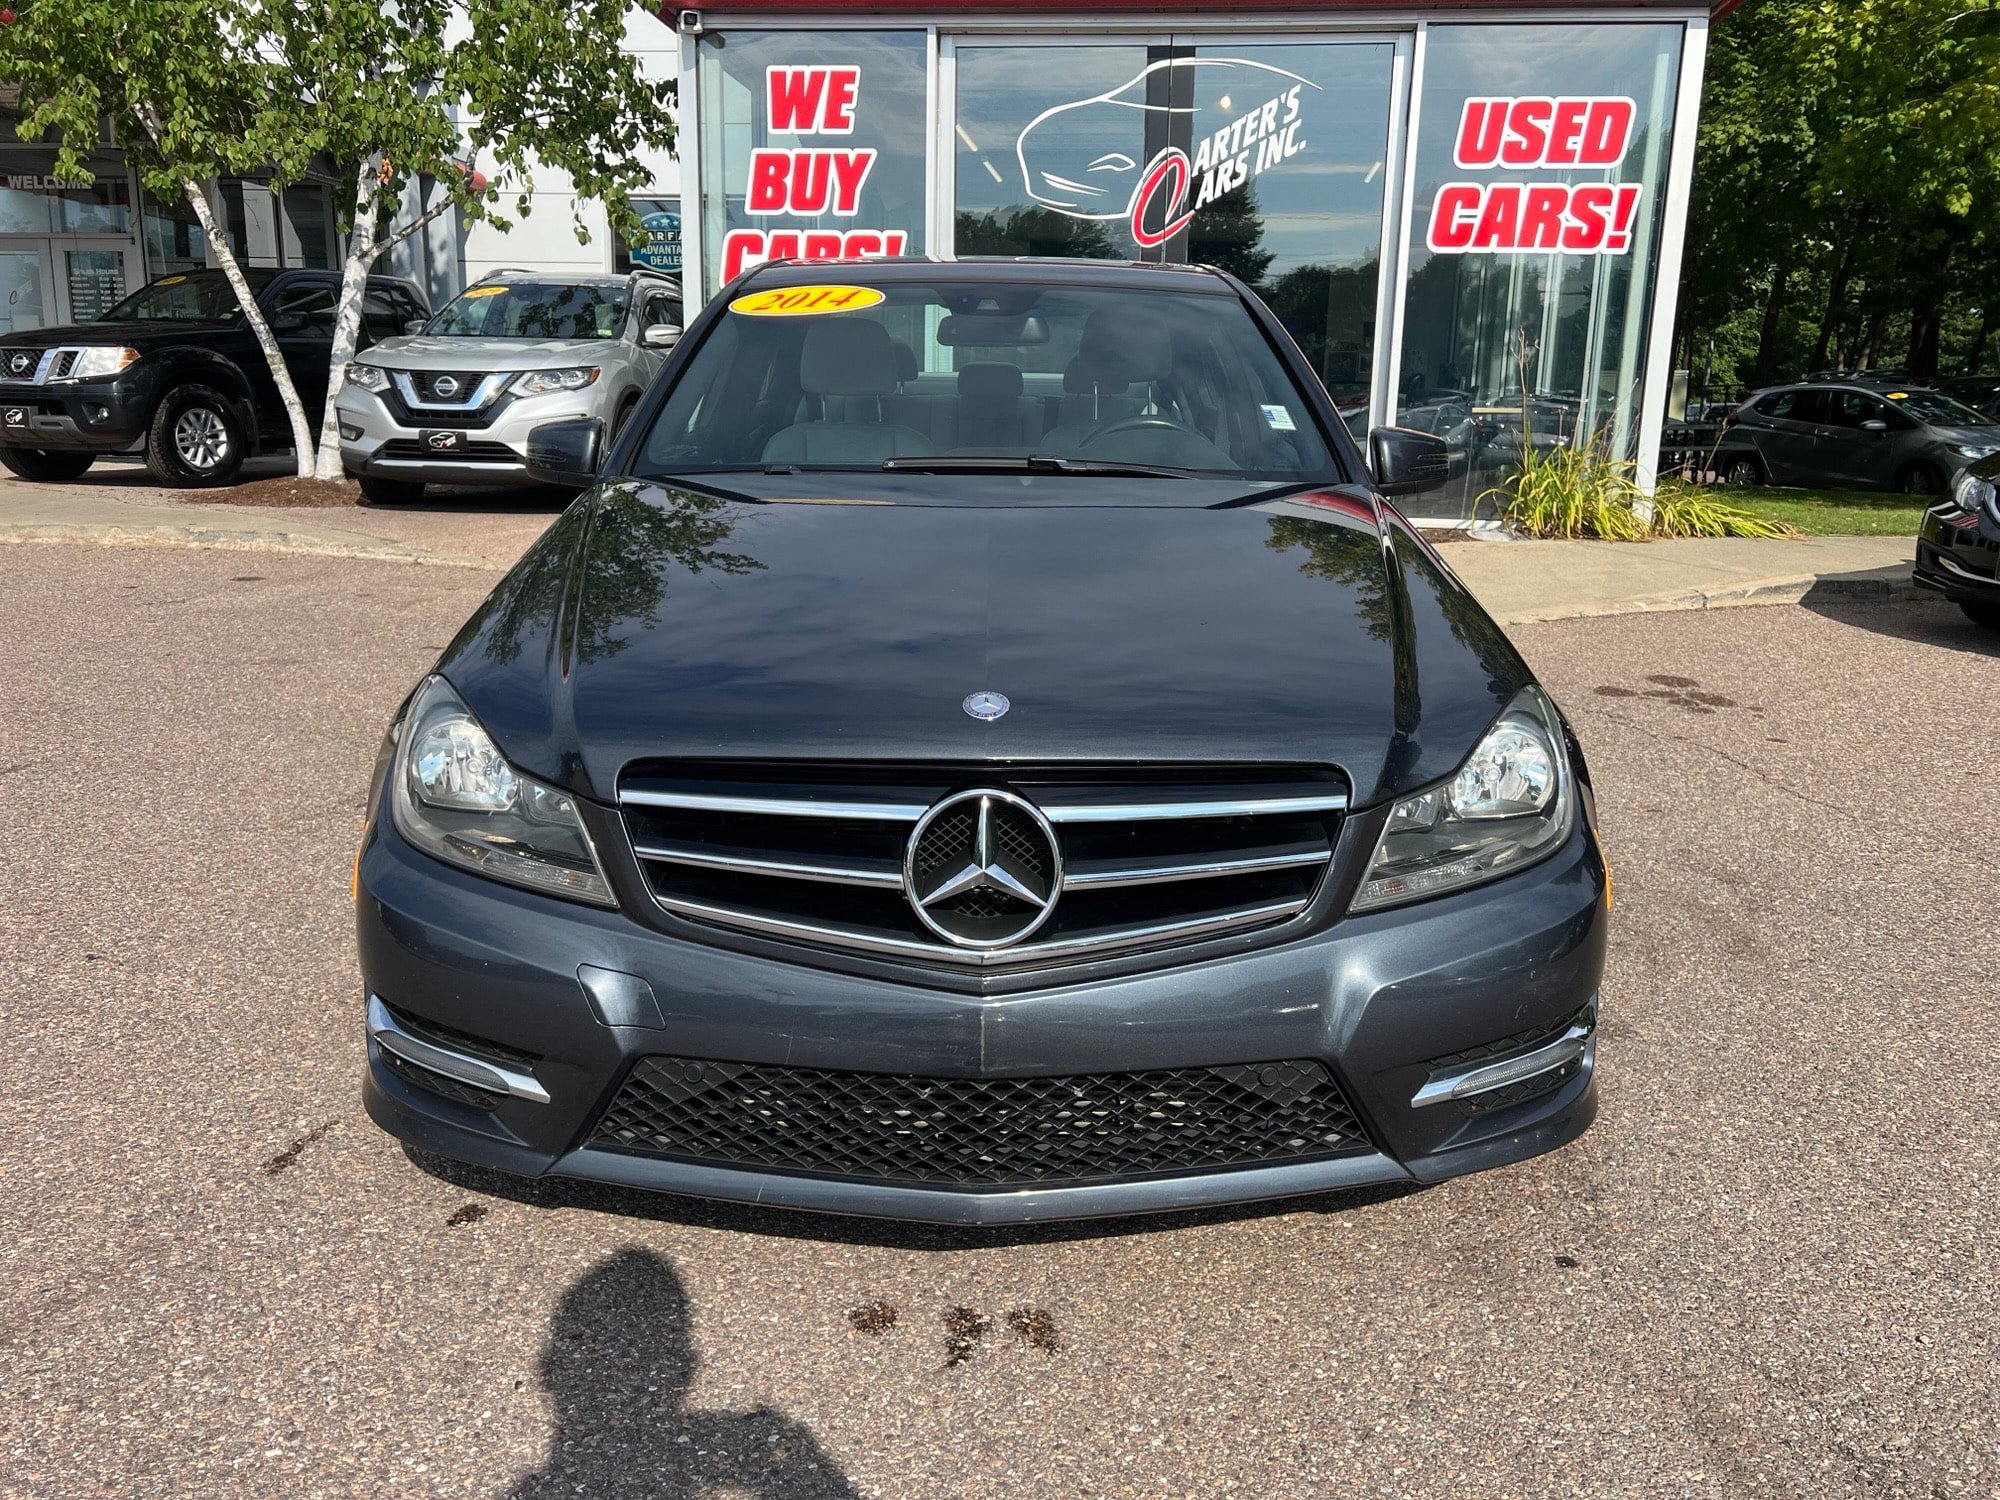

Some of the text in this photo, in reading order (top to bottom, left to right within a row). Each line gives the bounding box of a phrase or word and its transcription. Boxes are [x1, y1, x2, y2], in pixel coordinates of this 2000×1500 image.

[766, 65, 861, 134] WE
[1453, 96, 1637, 170] USED
[1254, 118, 1307, 176] INC.
[744, 147, 878, 217] BUY
[640, 244, 682, 255] ADVANTA
[1426, 182, 1643, 255] CARS!
[752, 289, 862, 311] 2014
